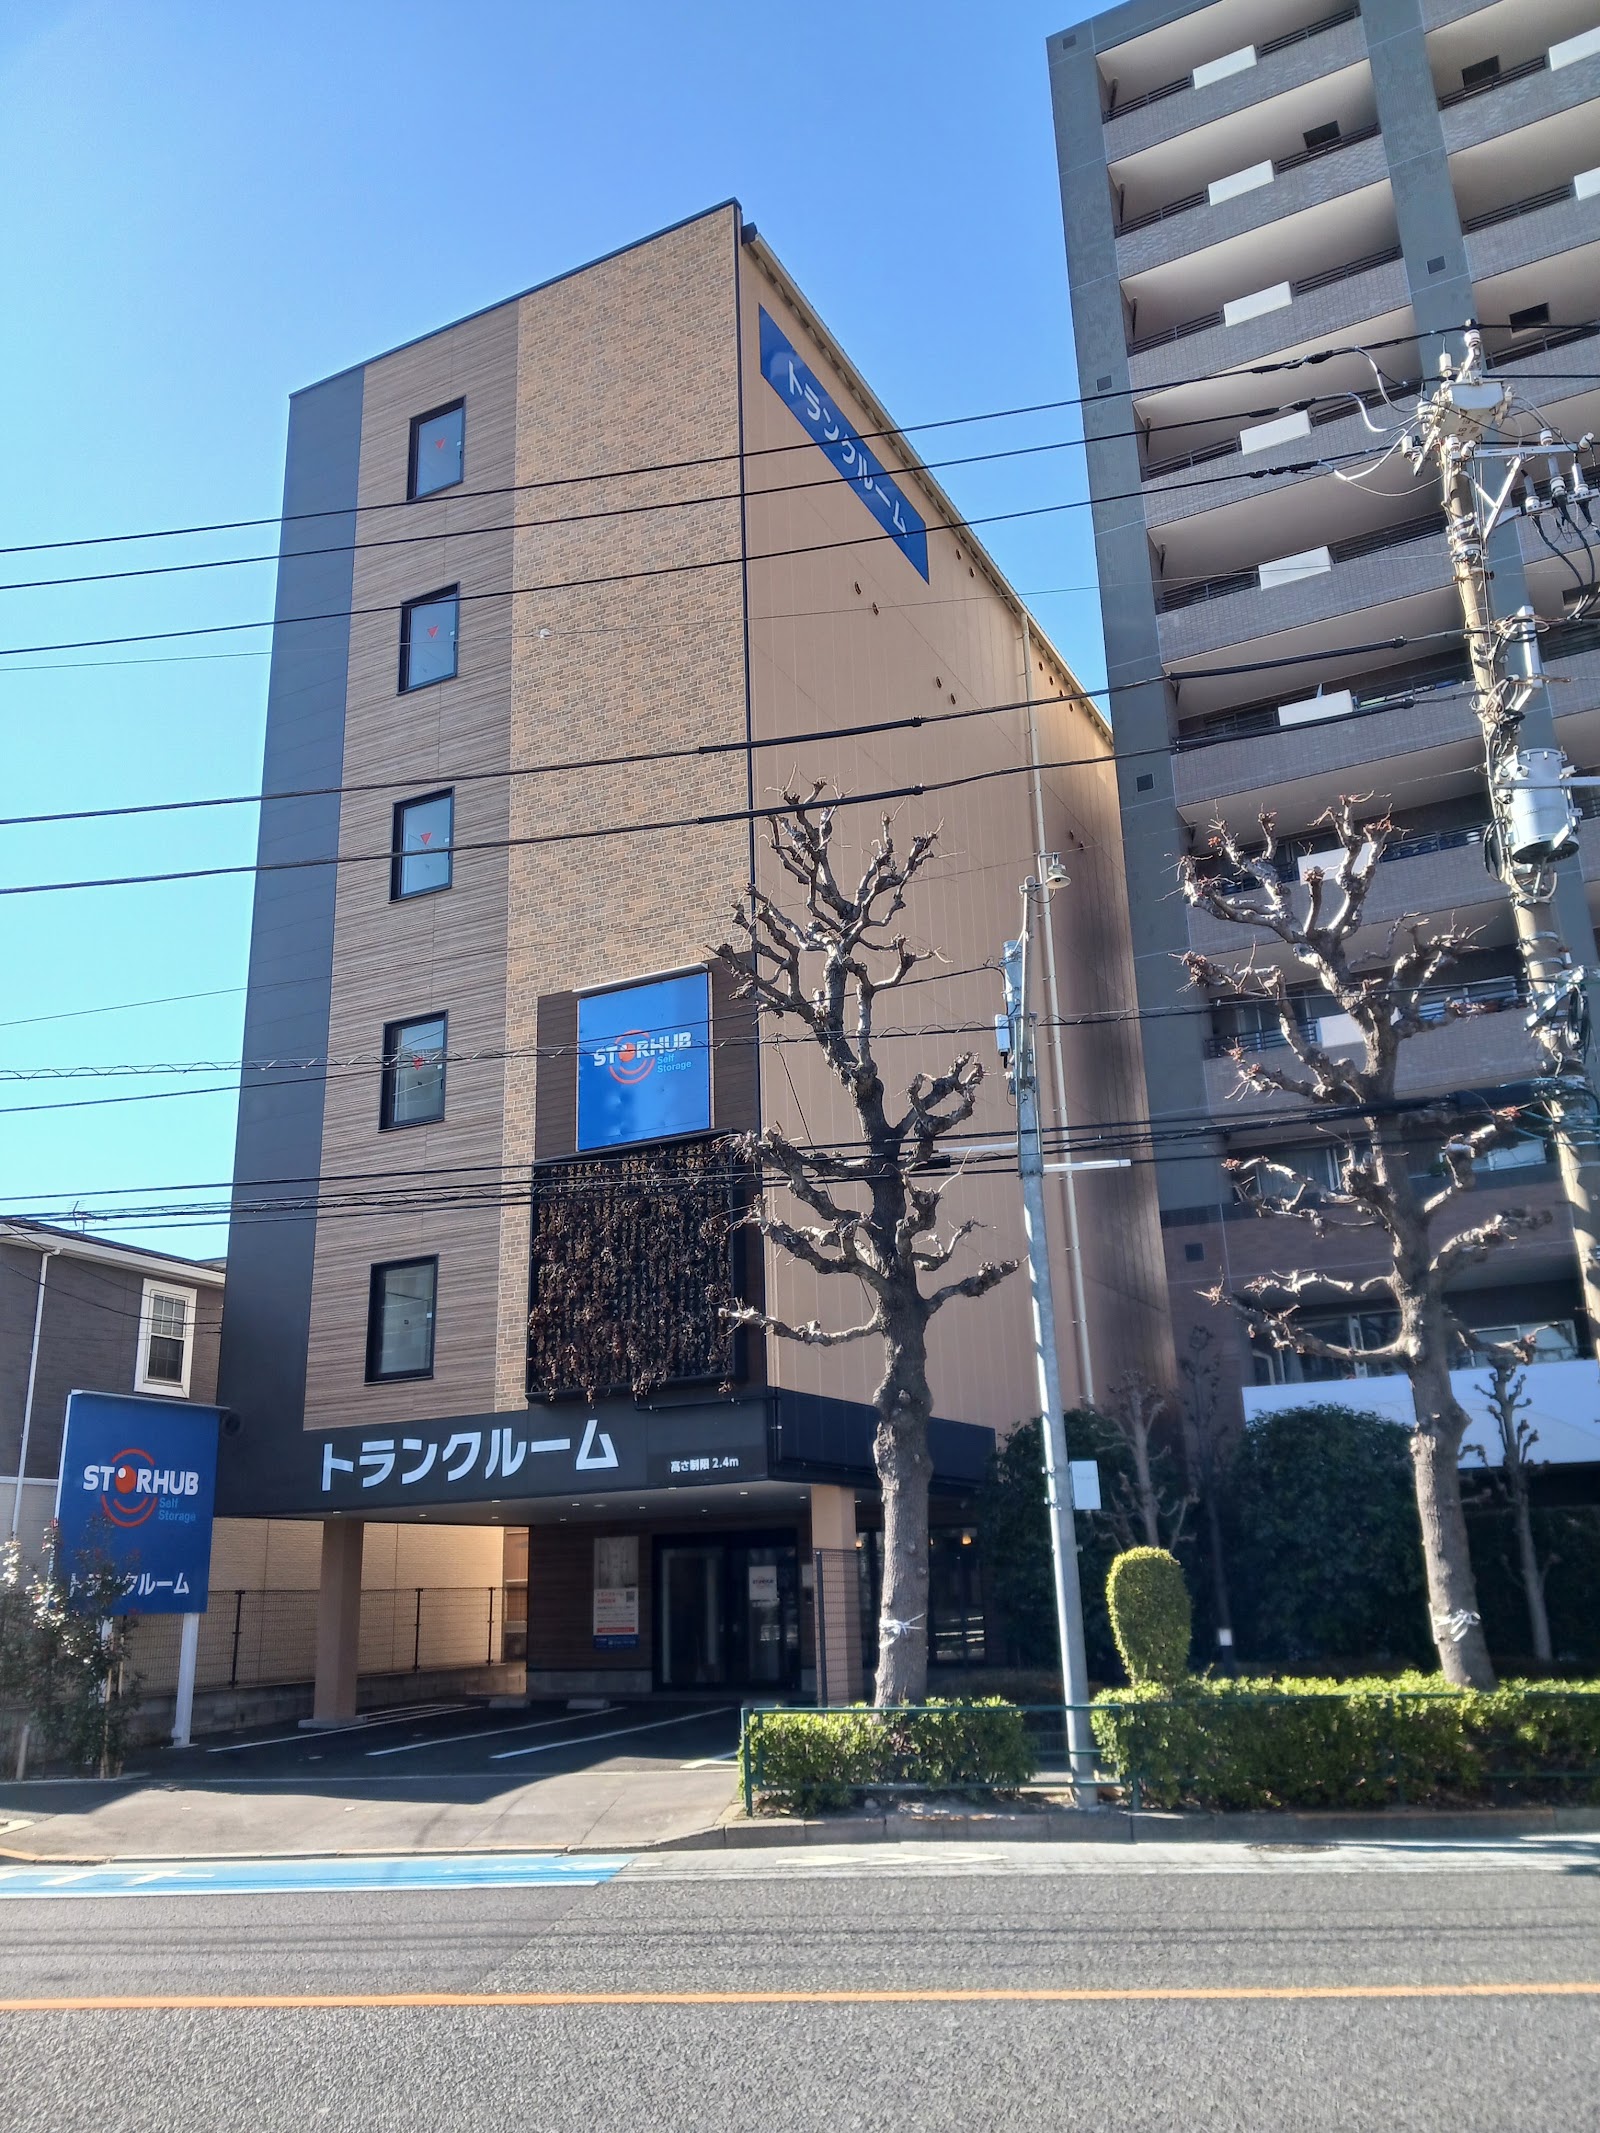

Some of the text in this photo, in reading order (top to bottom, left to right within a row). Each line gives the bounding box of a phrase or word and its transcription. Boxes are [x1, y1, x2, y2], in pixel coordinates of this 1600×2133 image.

[788, 360, 908, 538] トランクルーム
[593, 1031, 692, 1067] STORHUB
[657, 1054, 675, 1064] Self
[657, 1060, 692, 1073] Storage
[321, 1419, 620, 1492] トランクルーム
[670, 1456, 739, 1473] 高さ制限 2.4m
[83, 1464, 199, 1496] STORHUB
[159, 1497, 179, 1509] Self
[158, 1510, 196, 1524] Storage
